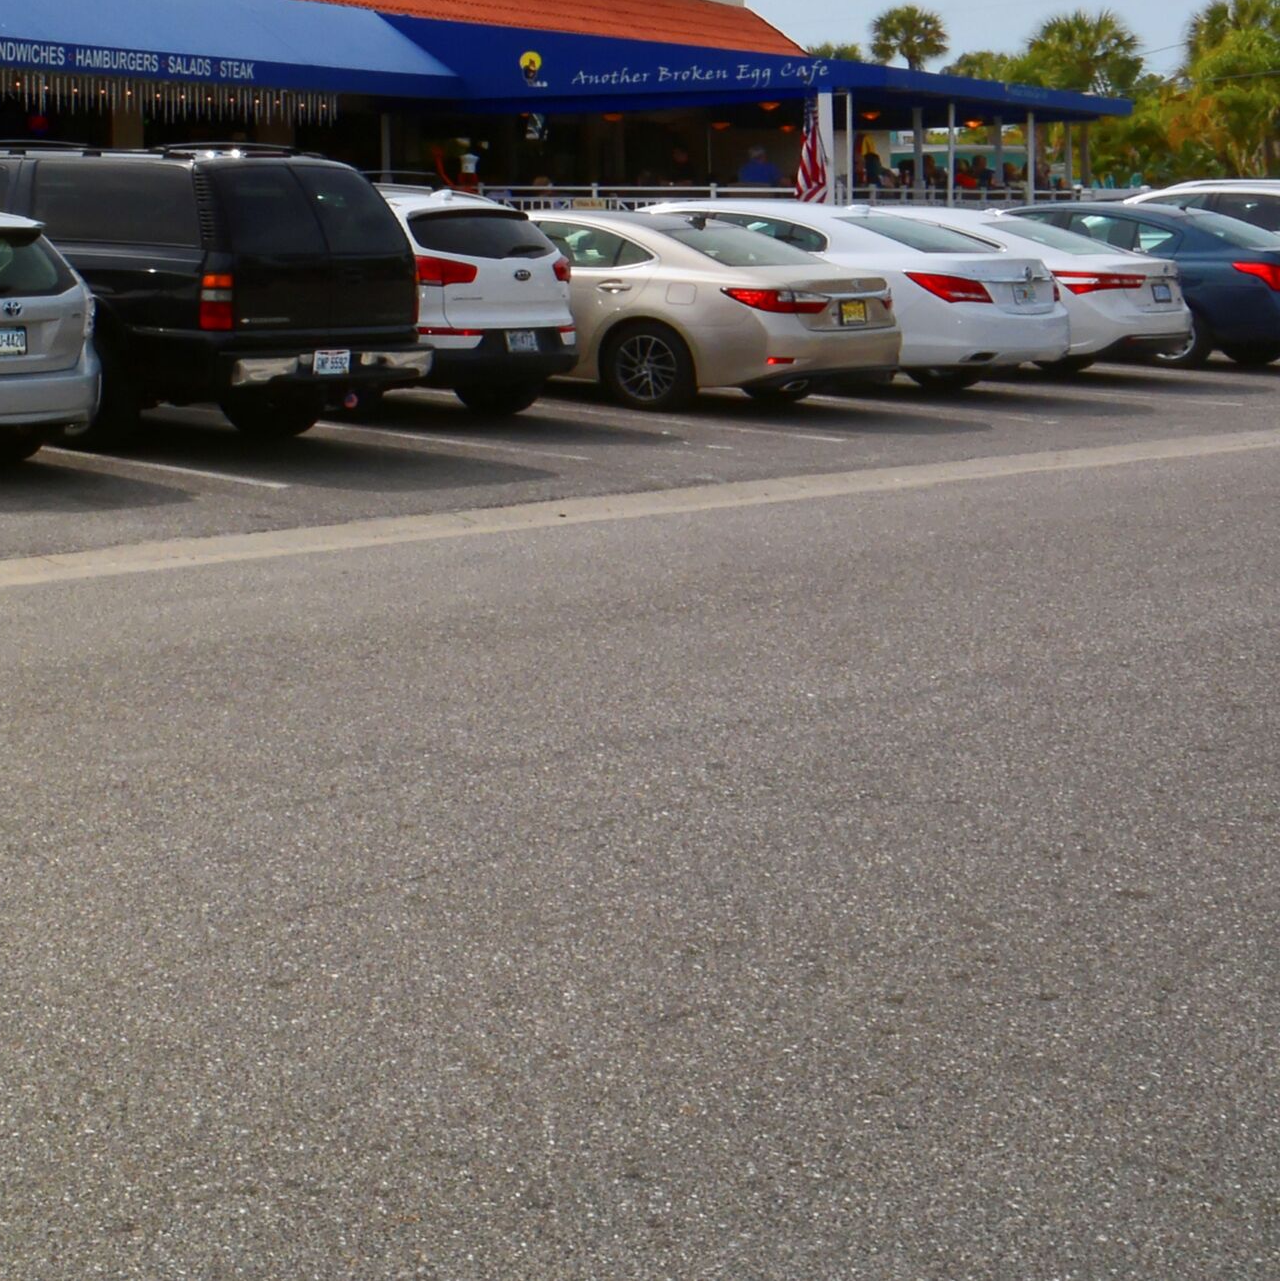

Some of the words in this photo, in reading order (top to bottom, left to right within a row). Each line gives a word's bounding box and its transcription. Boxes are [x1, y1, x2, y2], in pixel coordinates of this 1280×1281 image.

[75, 48, 159, 73] HAMBURGERS
[168, 56, 211, 76] SALADS
[219, 60, 255, 79] STEAK
[571, 68, 651, 85] Another
[658, 65, 728, 81] Broken
[736, 64, 772, 88] Egg
